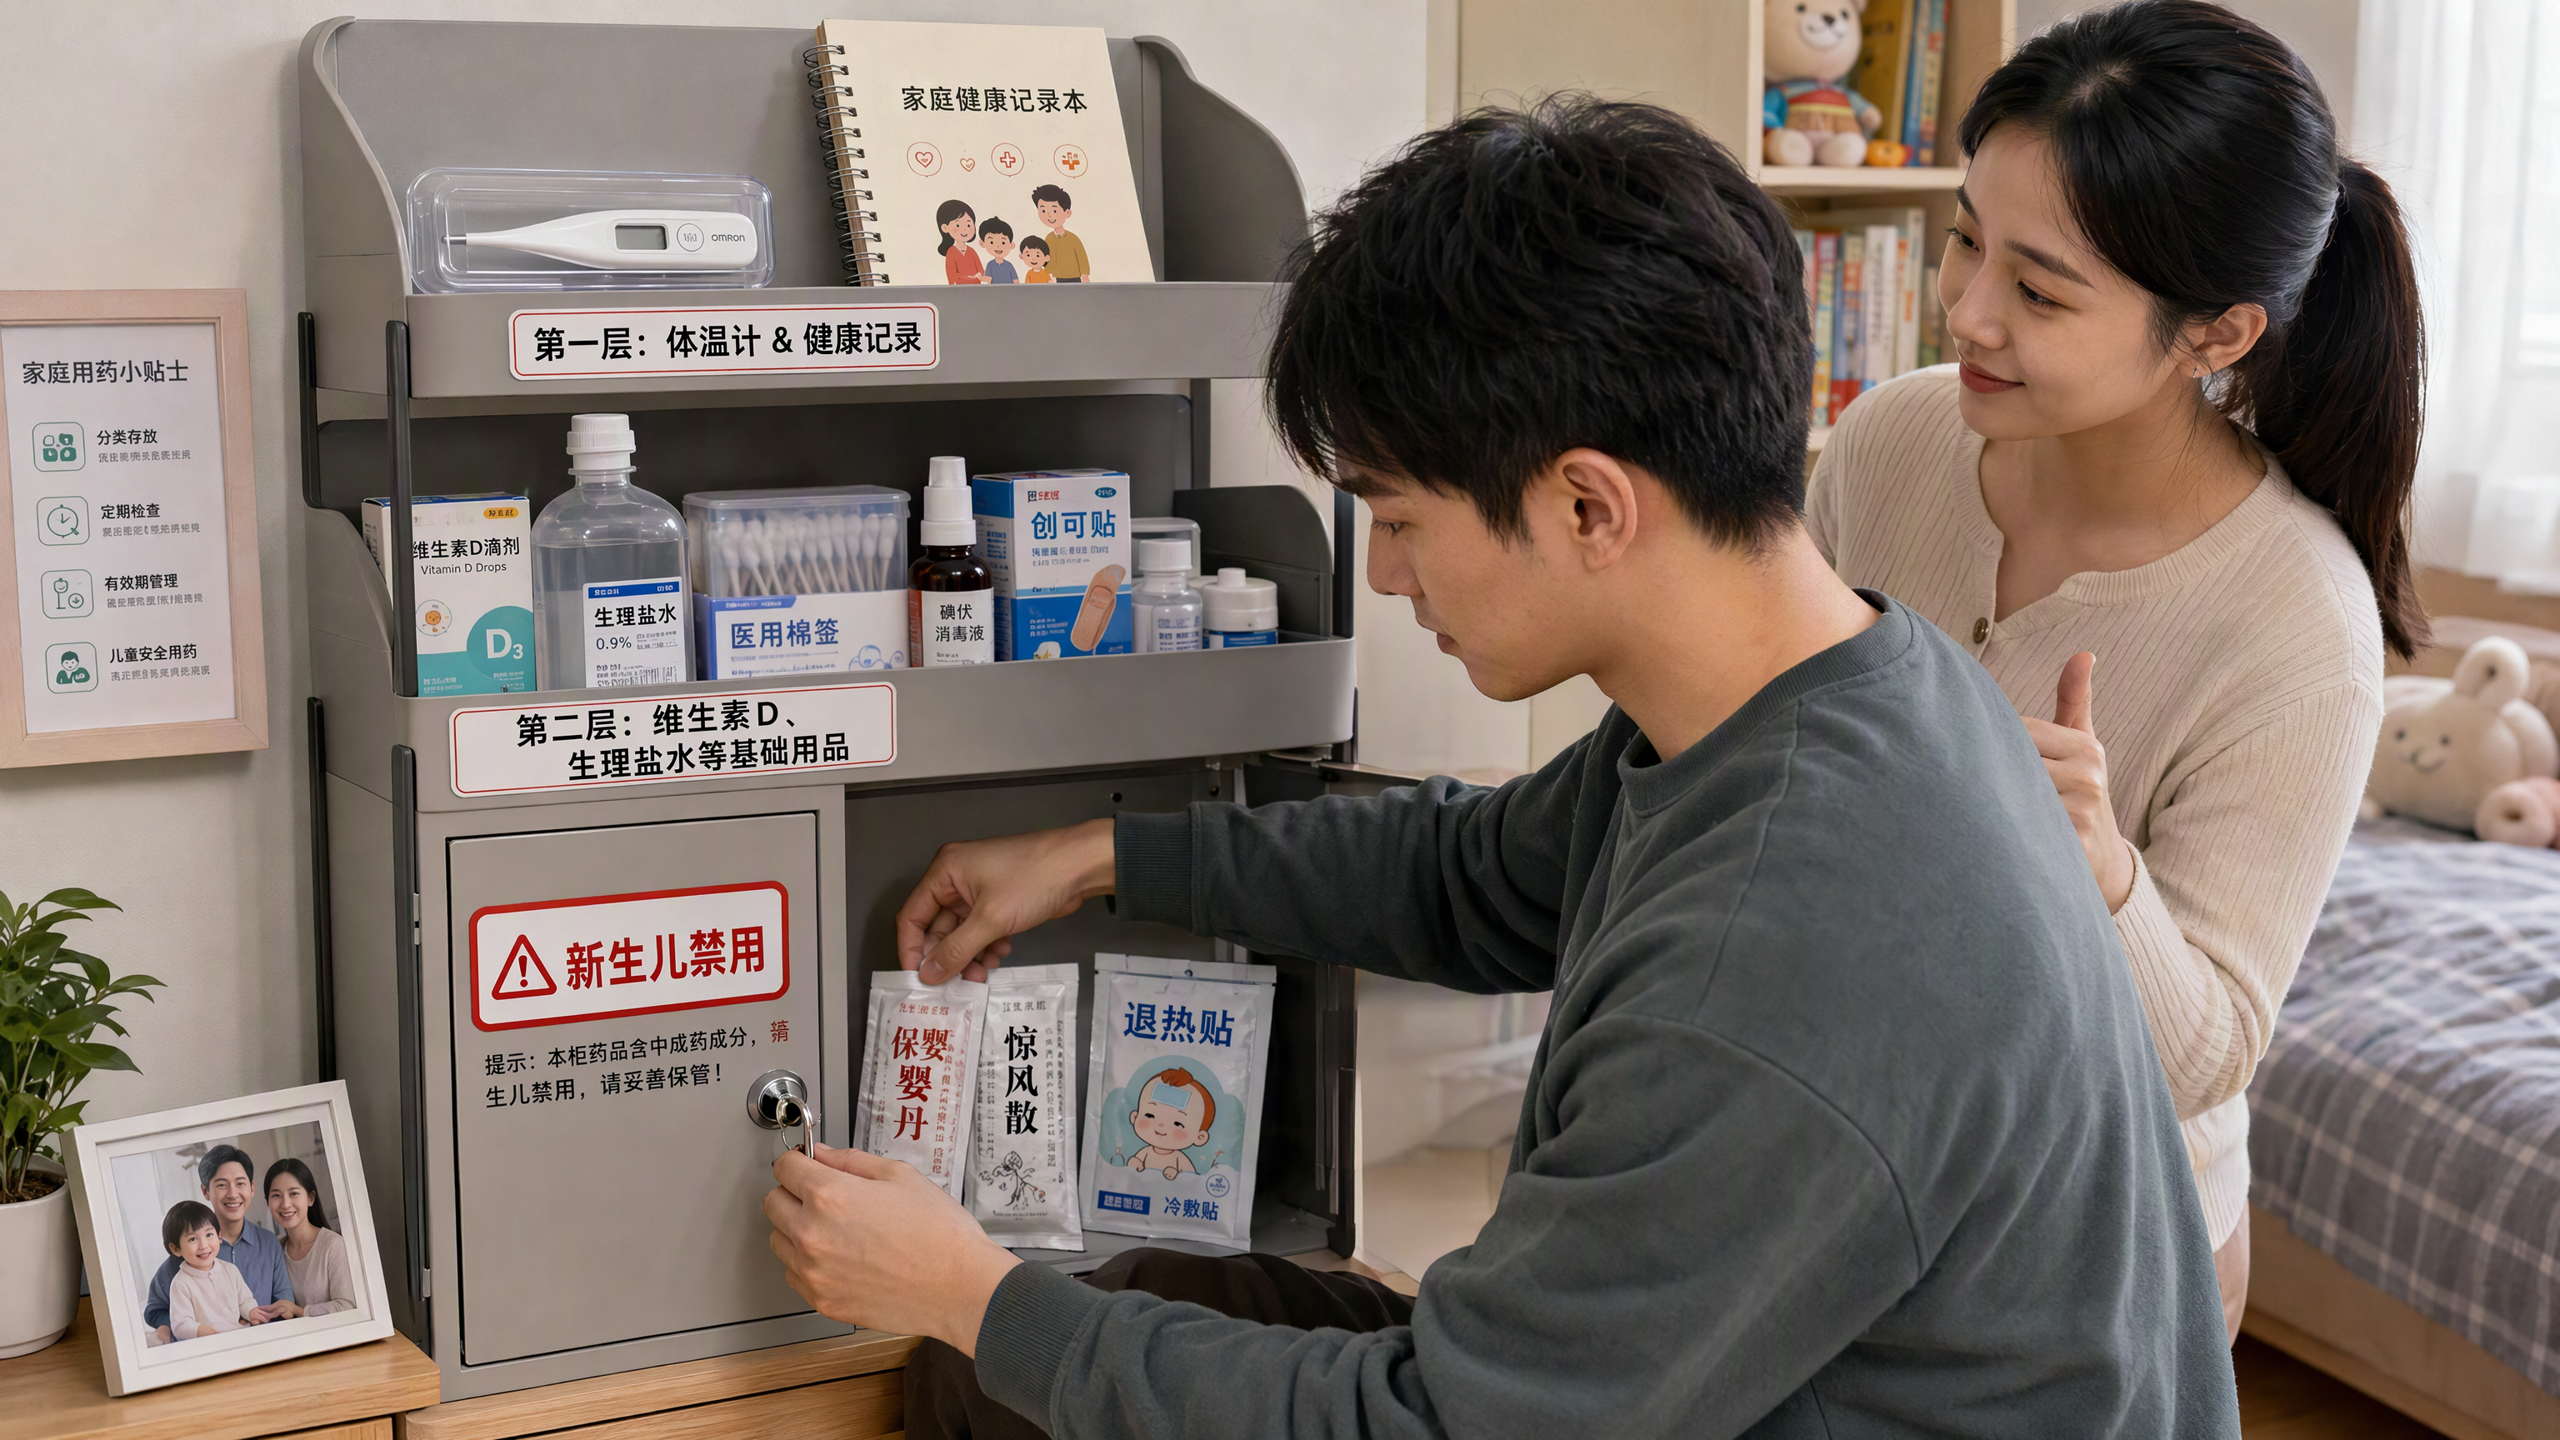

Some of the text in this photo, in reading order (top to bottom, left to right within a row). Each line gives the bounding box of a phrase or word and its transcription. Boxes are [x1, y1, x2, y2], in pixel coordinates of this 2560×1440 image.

[902, 85, 1088, 114] 家庭健康记录本
[534, 321, 922, 362] 第一层：体温计 & 健康记录
[22, 360, 189, 385] 家庭用药小贴士
[97, 429, 158, 446] 分类存放
[101, 503, 161, 520] 定期检查
[1030, 509, 1116, 540] 创可贴
[412, 536, 520, 560] 维生素D滴剂
[420, 562, 507, 575] Vitamin D Drops
[104, 573, 179, 592] 有效期管理
[594, 603, 677, 628] 生理盐水
[596, 636, 632, 650] 0.9%
[731, 618, 839, 649] 医用棉签
[109, 643, 197, 664] 儿童安全用药
[567, 732, 851, 782] 生理盐水等基础用品
[566, 925, 766, 991] 新生儿禁用
[1123, 1002, 1235, 1048] 退热贴
[485, 1063, 722, 1109] 生儿禁用，请妥善保管！
[1003, 1026, 1039, 1135] 惊风散
[1164, 1196, 1219, 1221] 冷敷贴
